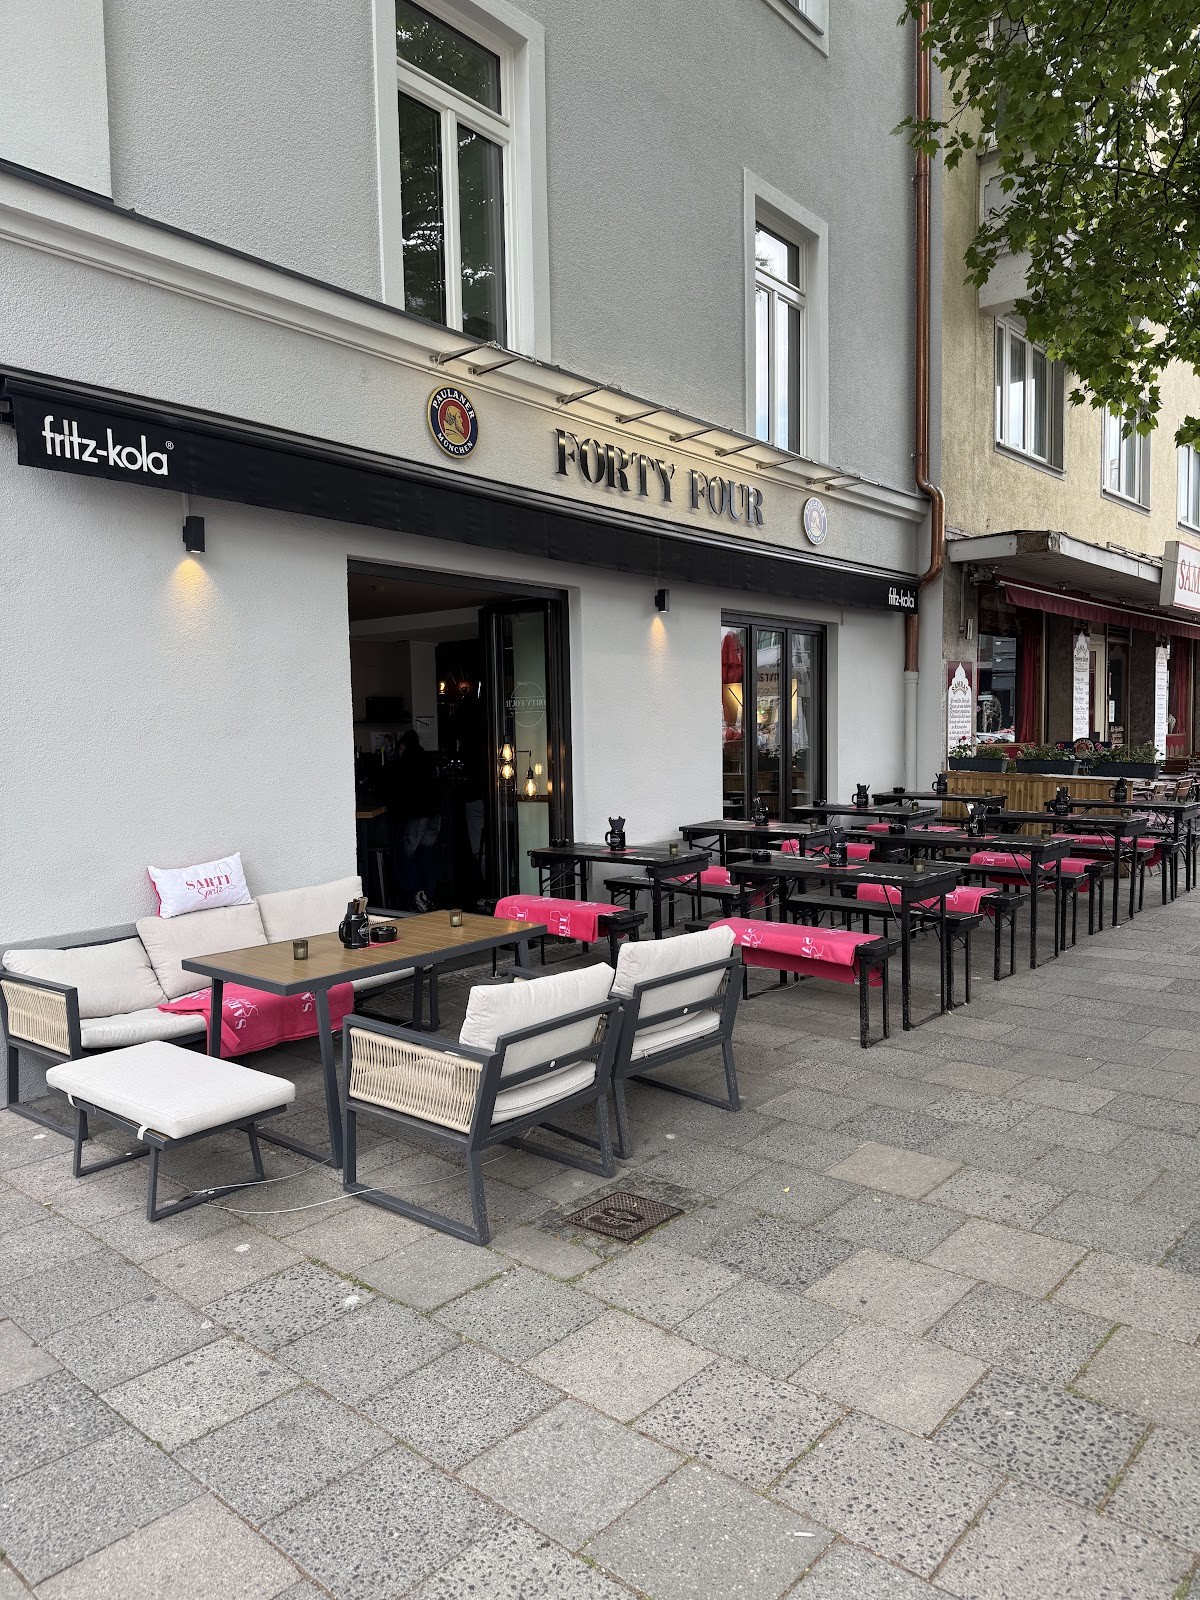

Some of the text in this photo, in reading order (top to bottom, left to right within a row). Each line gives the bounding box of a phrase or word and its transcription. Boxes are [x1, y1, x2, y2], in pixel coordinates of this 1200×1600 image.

[432, 388, 475, 419] PAULANER
[555, 428, 764, 525] FORTY FOUR
[185, 874, 231, 890] SARTI
